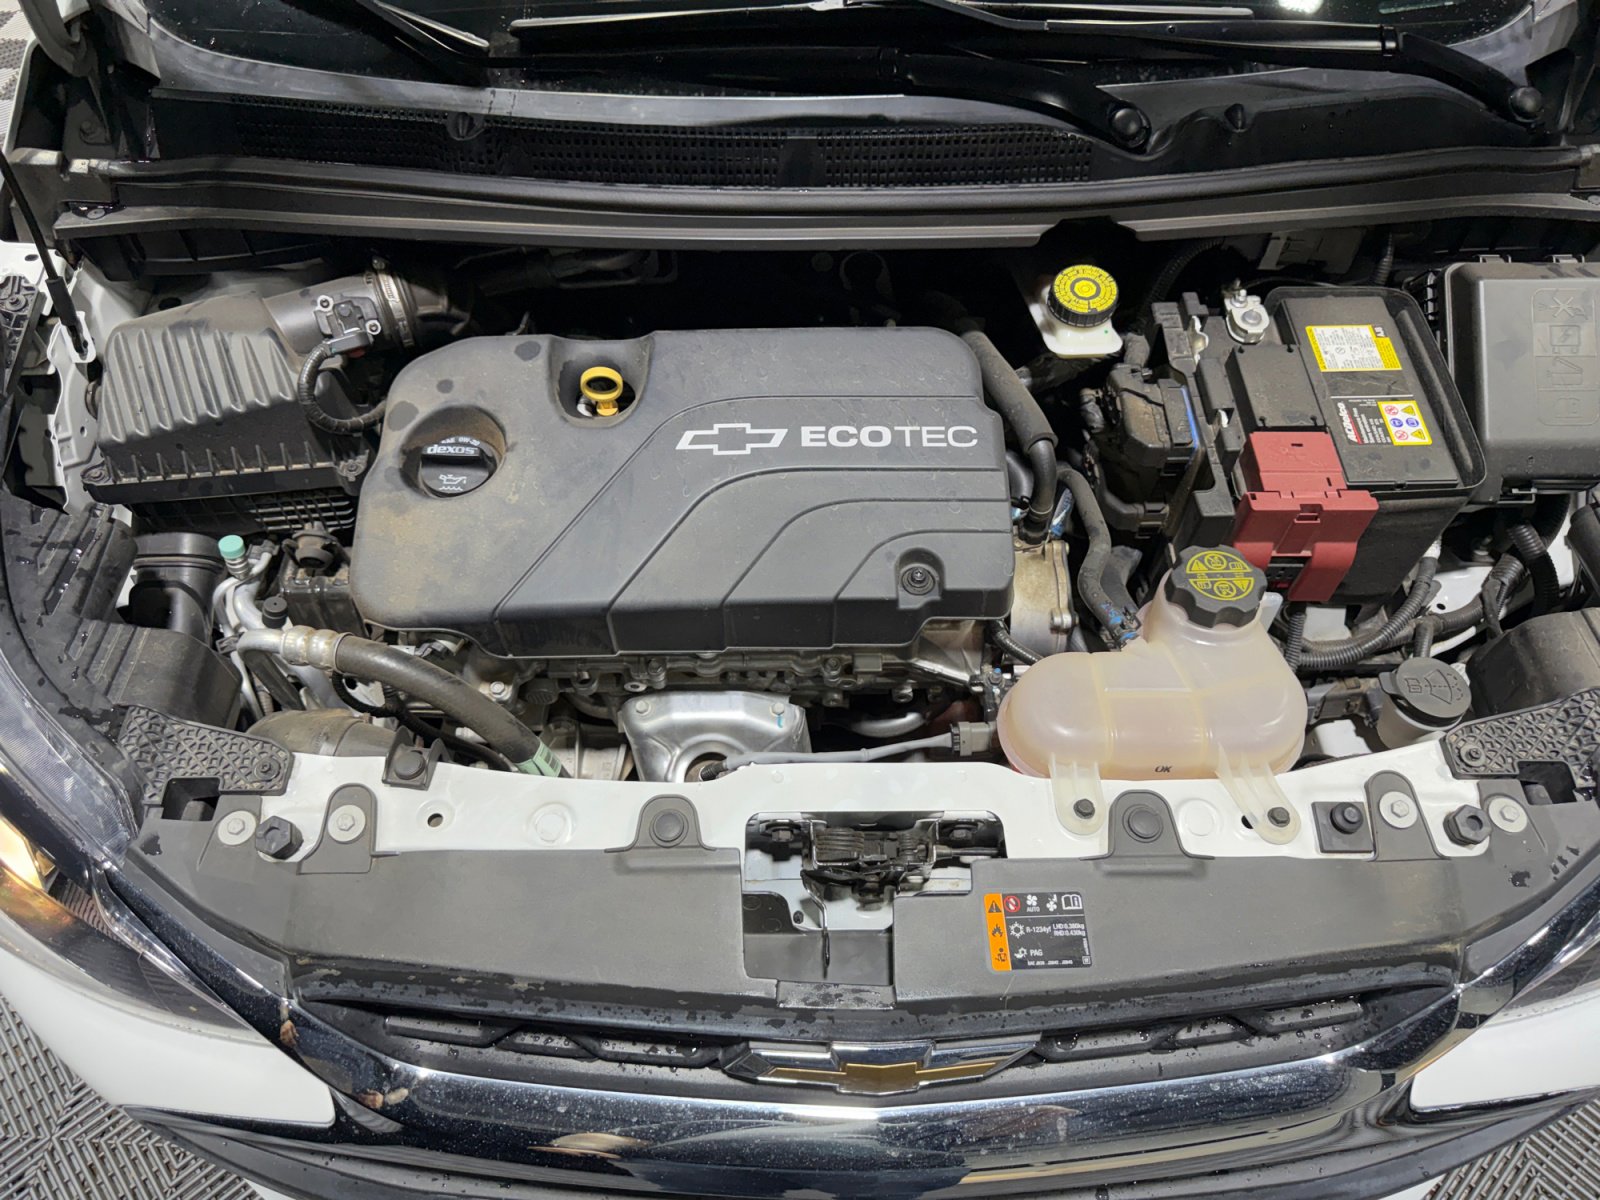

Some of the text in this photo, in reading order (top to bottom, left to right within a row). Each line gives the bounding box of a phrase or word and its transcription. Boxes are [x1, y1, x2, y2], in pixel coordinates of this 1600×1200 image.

[1337, 401, 1359, 443] ACDelco
[800, 425, 978, 448] ECOTEC
[427, 444, 476, 455] dexos
[1155, 765, 1172, 773] OK
[1029, 949, 1044, 957] PAG
